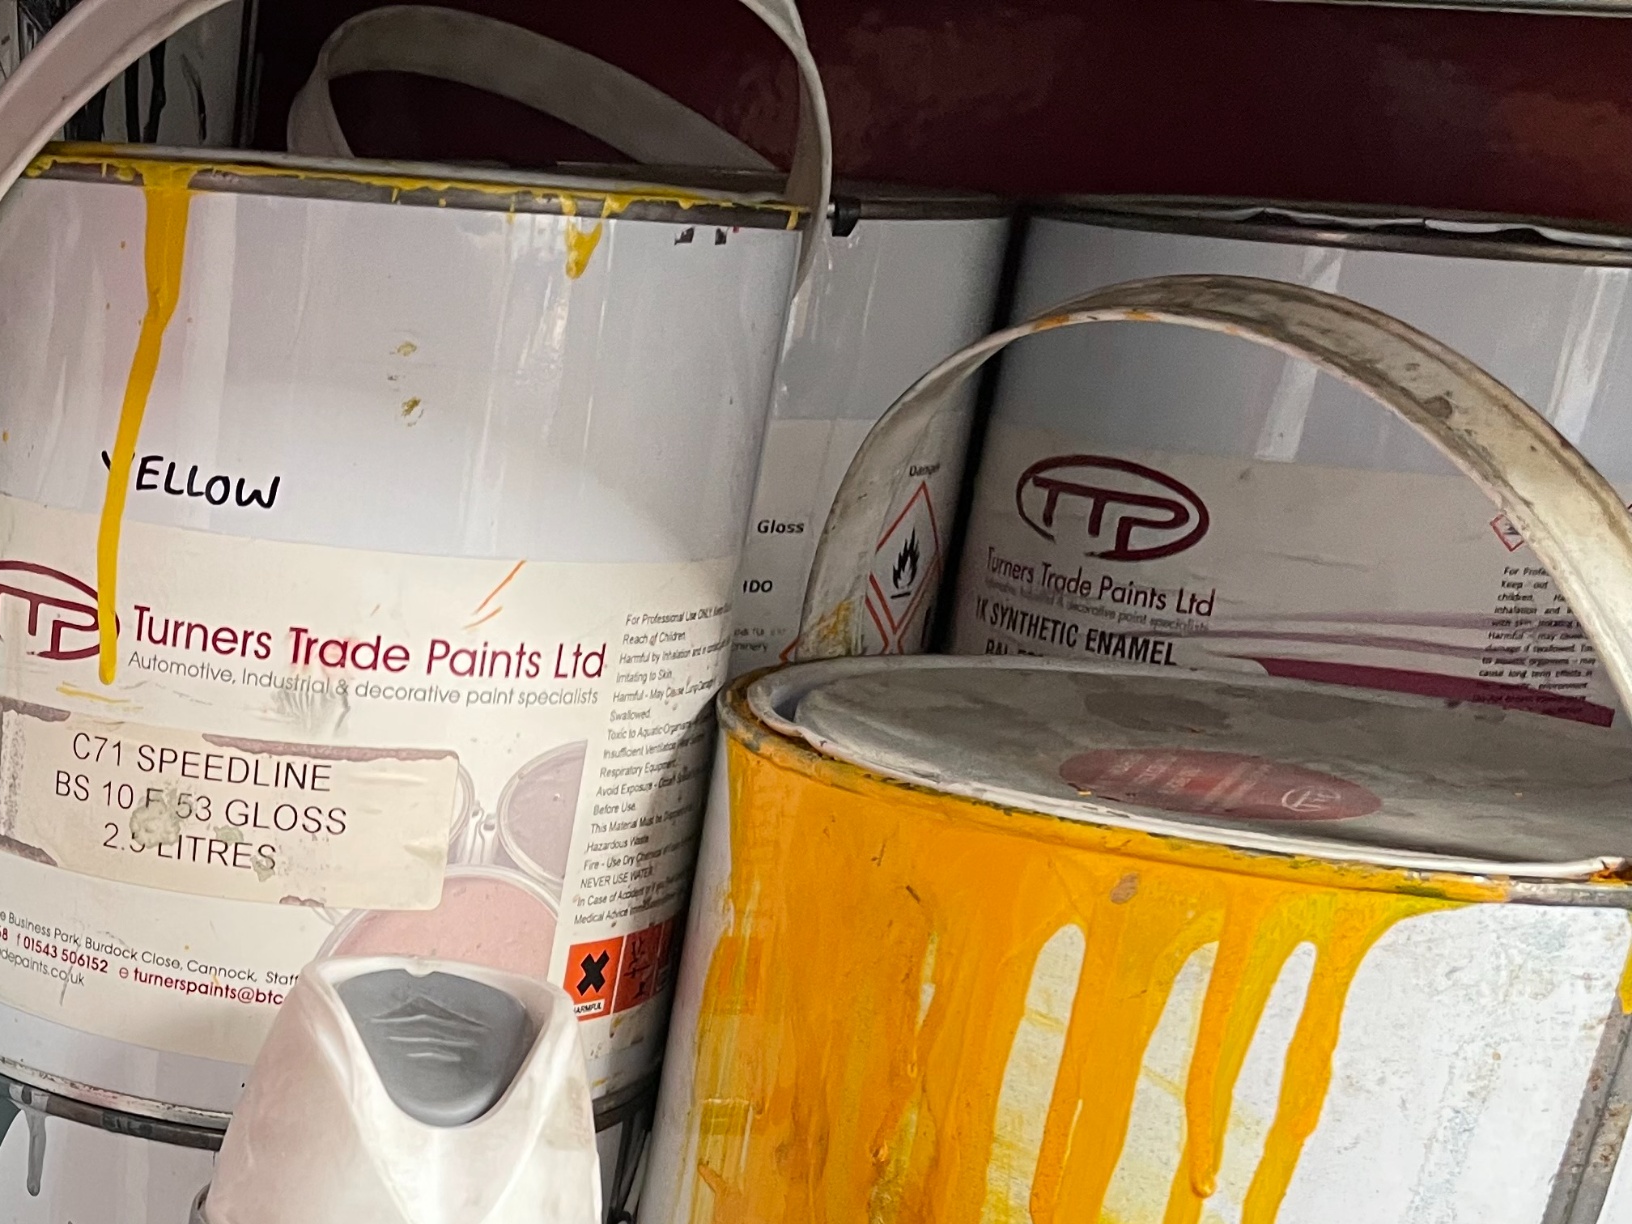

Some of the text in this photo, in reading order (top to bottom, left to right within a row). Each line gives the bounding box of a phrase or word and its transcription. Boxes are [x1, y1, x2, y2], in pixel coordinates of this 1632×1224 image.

[757, 519, 805, 534] Gloss
[986, 547, 1034, 583] Turners
[1041, 561, 1091, 596] Trade
[1098, 575, 1166, 610] Paints
[1176, 587, 1216, 616] Ltd
[134, 604, 607, 678] Turners Trade Paints Ltd
[622, 634, 648, 645] Reach
[626, 613, 640, 626] For
[990, 602, 1177, 666] SYNTHETIC ENAMEL
[128, 651, 599, 708] Automotive, Industrial decorative paint specialists
[73, 732, 332, 792] C71 SPEEDLINE
[55, 770, 347, 835] BS 10 53 GLOSS
[580, 873, 629, 889] NEVER USE
[8, 912, 51, 938] Business
[85, 936, 138, 961] Burdock
[23, 936, 58, 959] 01543
[61, 948, 109, 973] 506152
